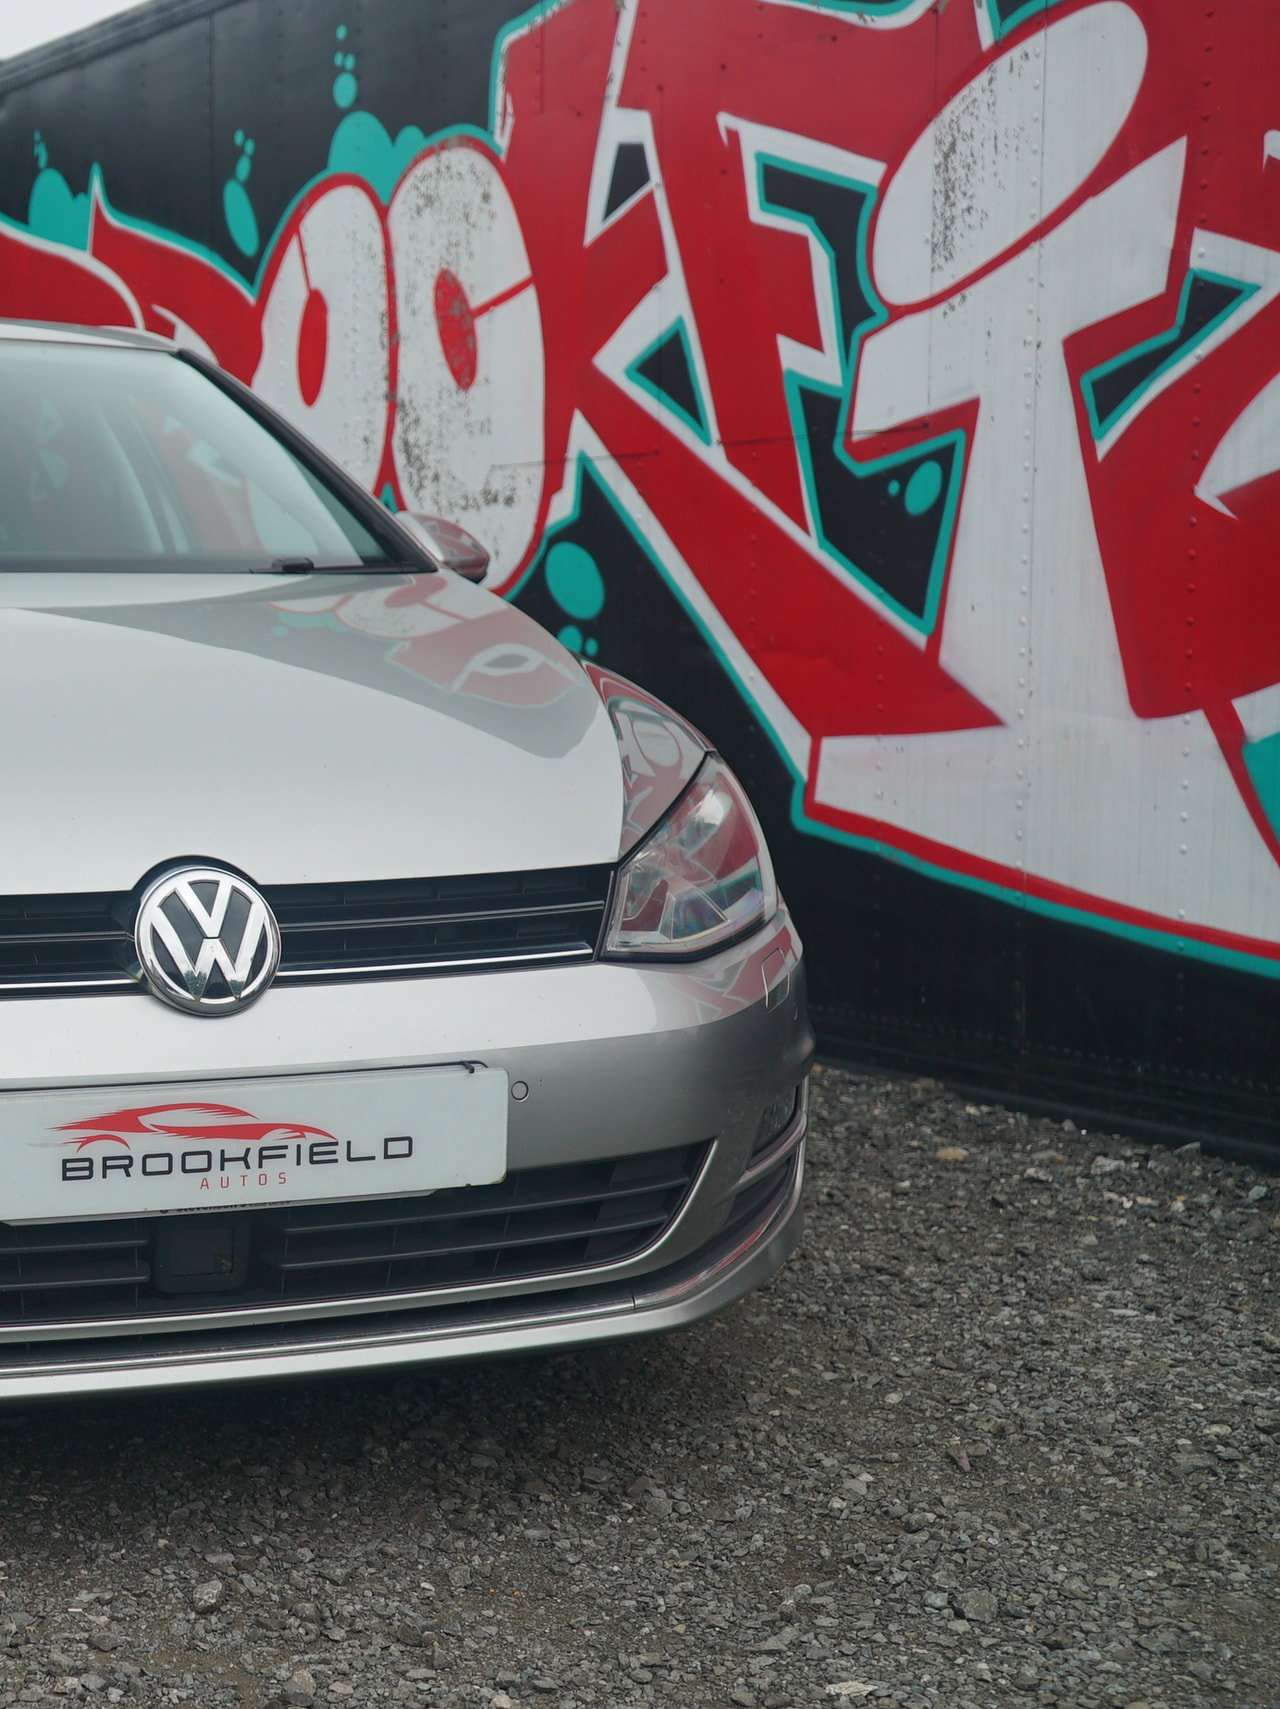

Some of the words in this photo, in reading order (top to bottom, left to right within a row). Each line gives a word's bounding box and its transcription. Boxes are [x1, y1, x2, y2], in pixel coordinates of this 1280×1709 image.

[138, 870, 276, 1010] VW
[61, 1136, 414, 1182] BROOKFIELD
[199, 1171, 289, 1190] AUTOS
